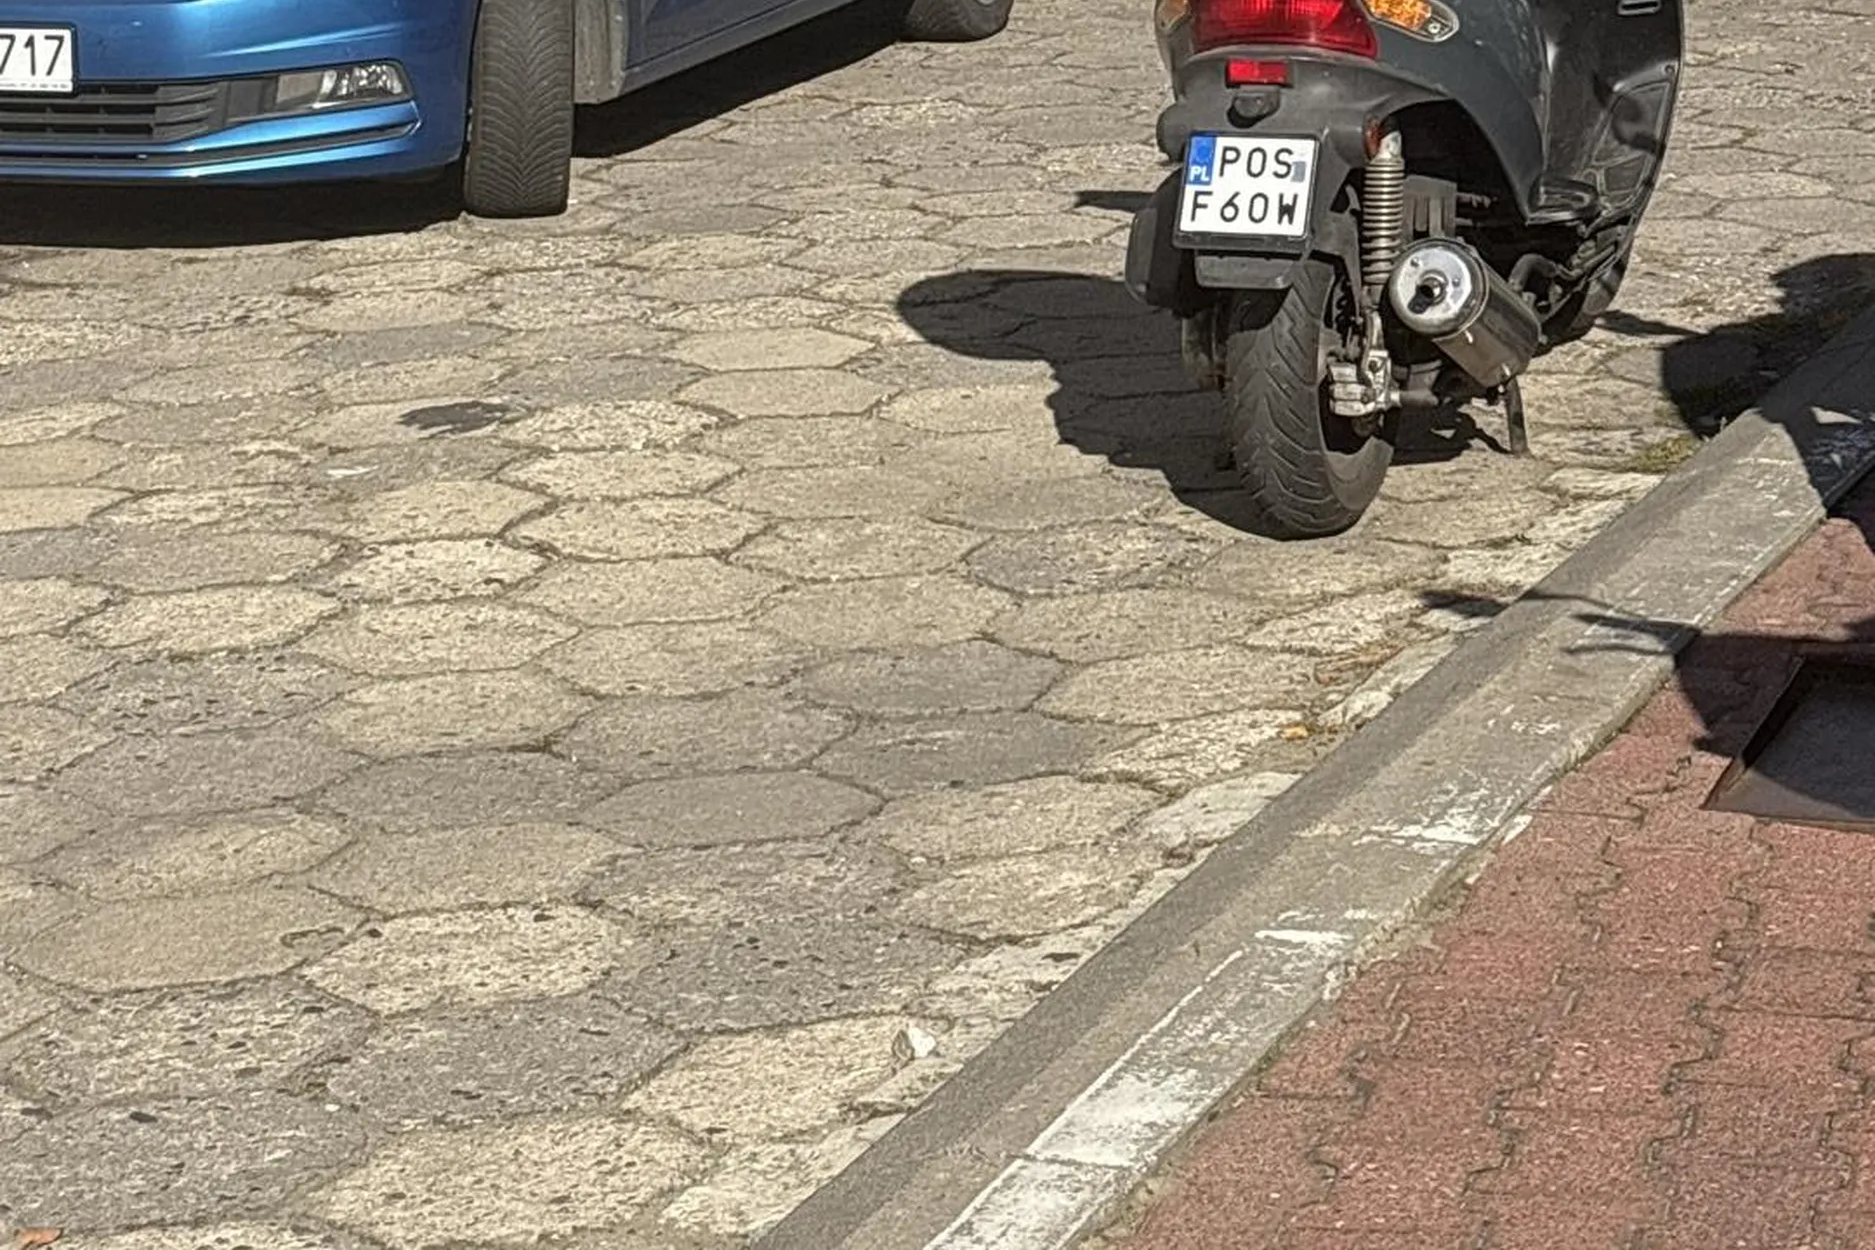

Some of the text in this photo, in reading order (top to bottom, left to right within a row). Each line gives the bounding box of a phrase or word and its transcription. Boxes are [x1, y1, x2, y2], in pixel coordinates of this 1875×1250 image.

[1190, 146, 1294, 181] PL POS
[1190, 190, 1299, 225] F60W
